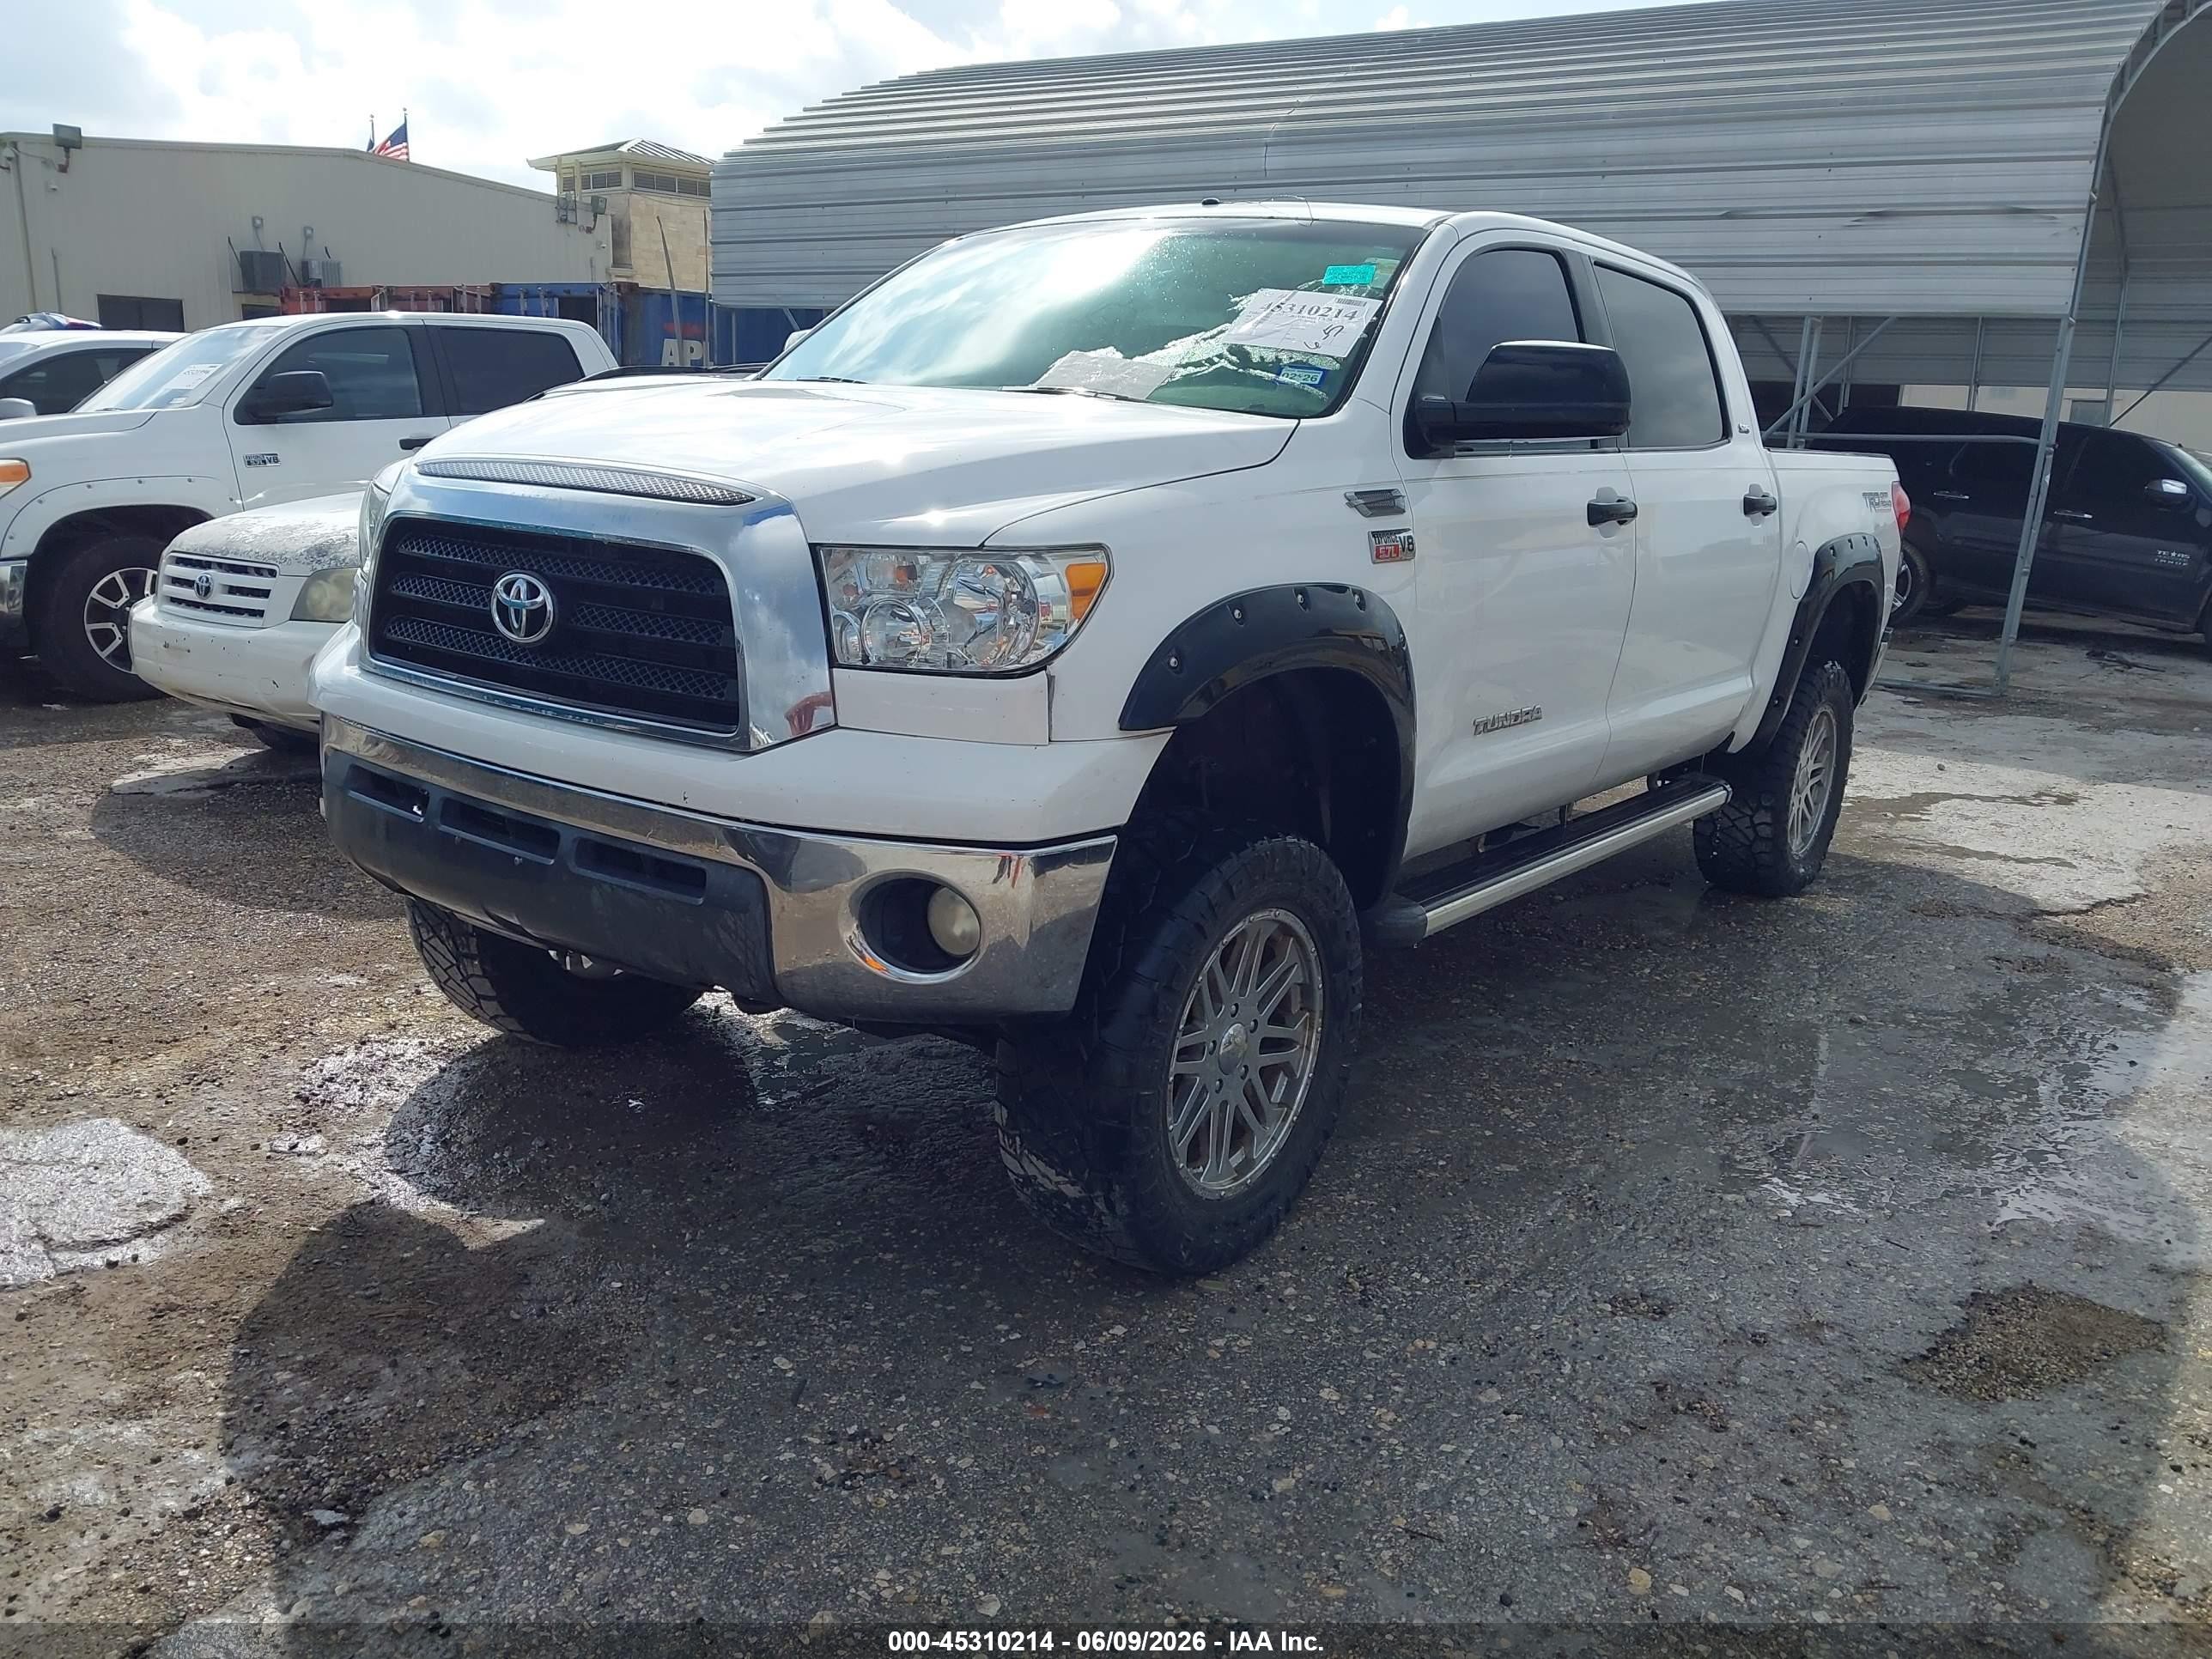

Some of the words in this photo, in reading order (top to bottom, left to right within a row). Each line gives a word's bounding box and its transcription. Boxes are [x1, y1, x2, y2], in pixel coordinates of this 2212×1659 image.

[1302, 374, 1319, 382] 26
[1398, 535, 1415, 552] V8
[1473, 704, 1542, 736] TUNDRA
